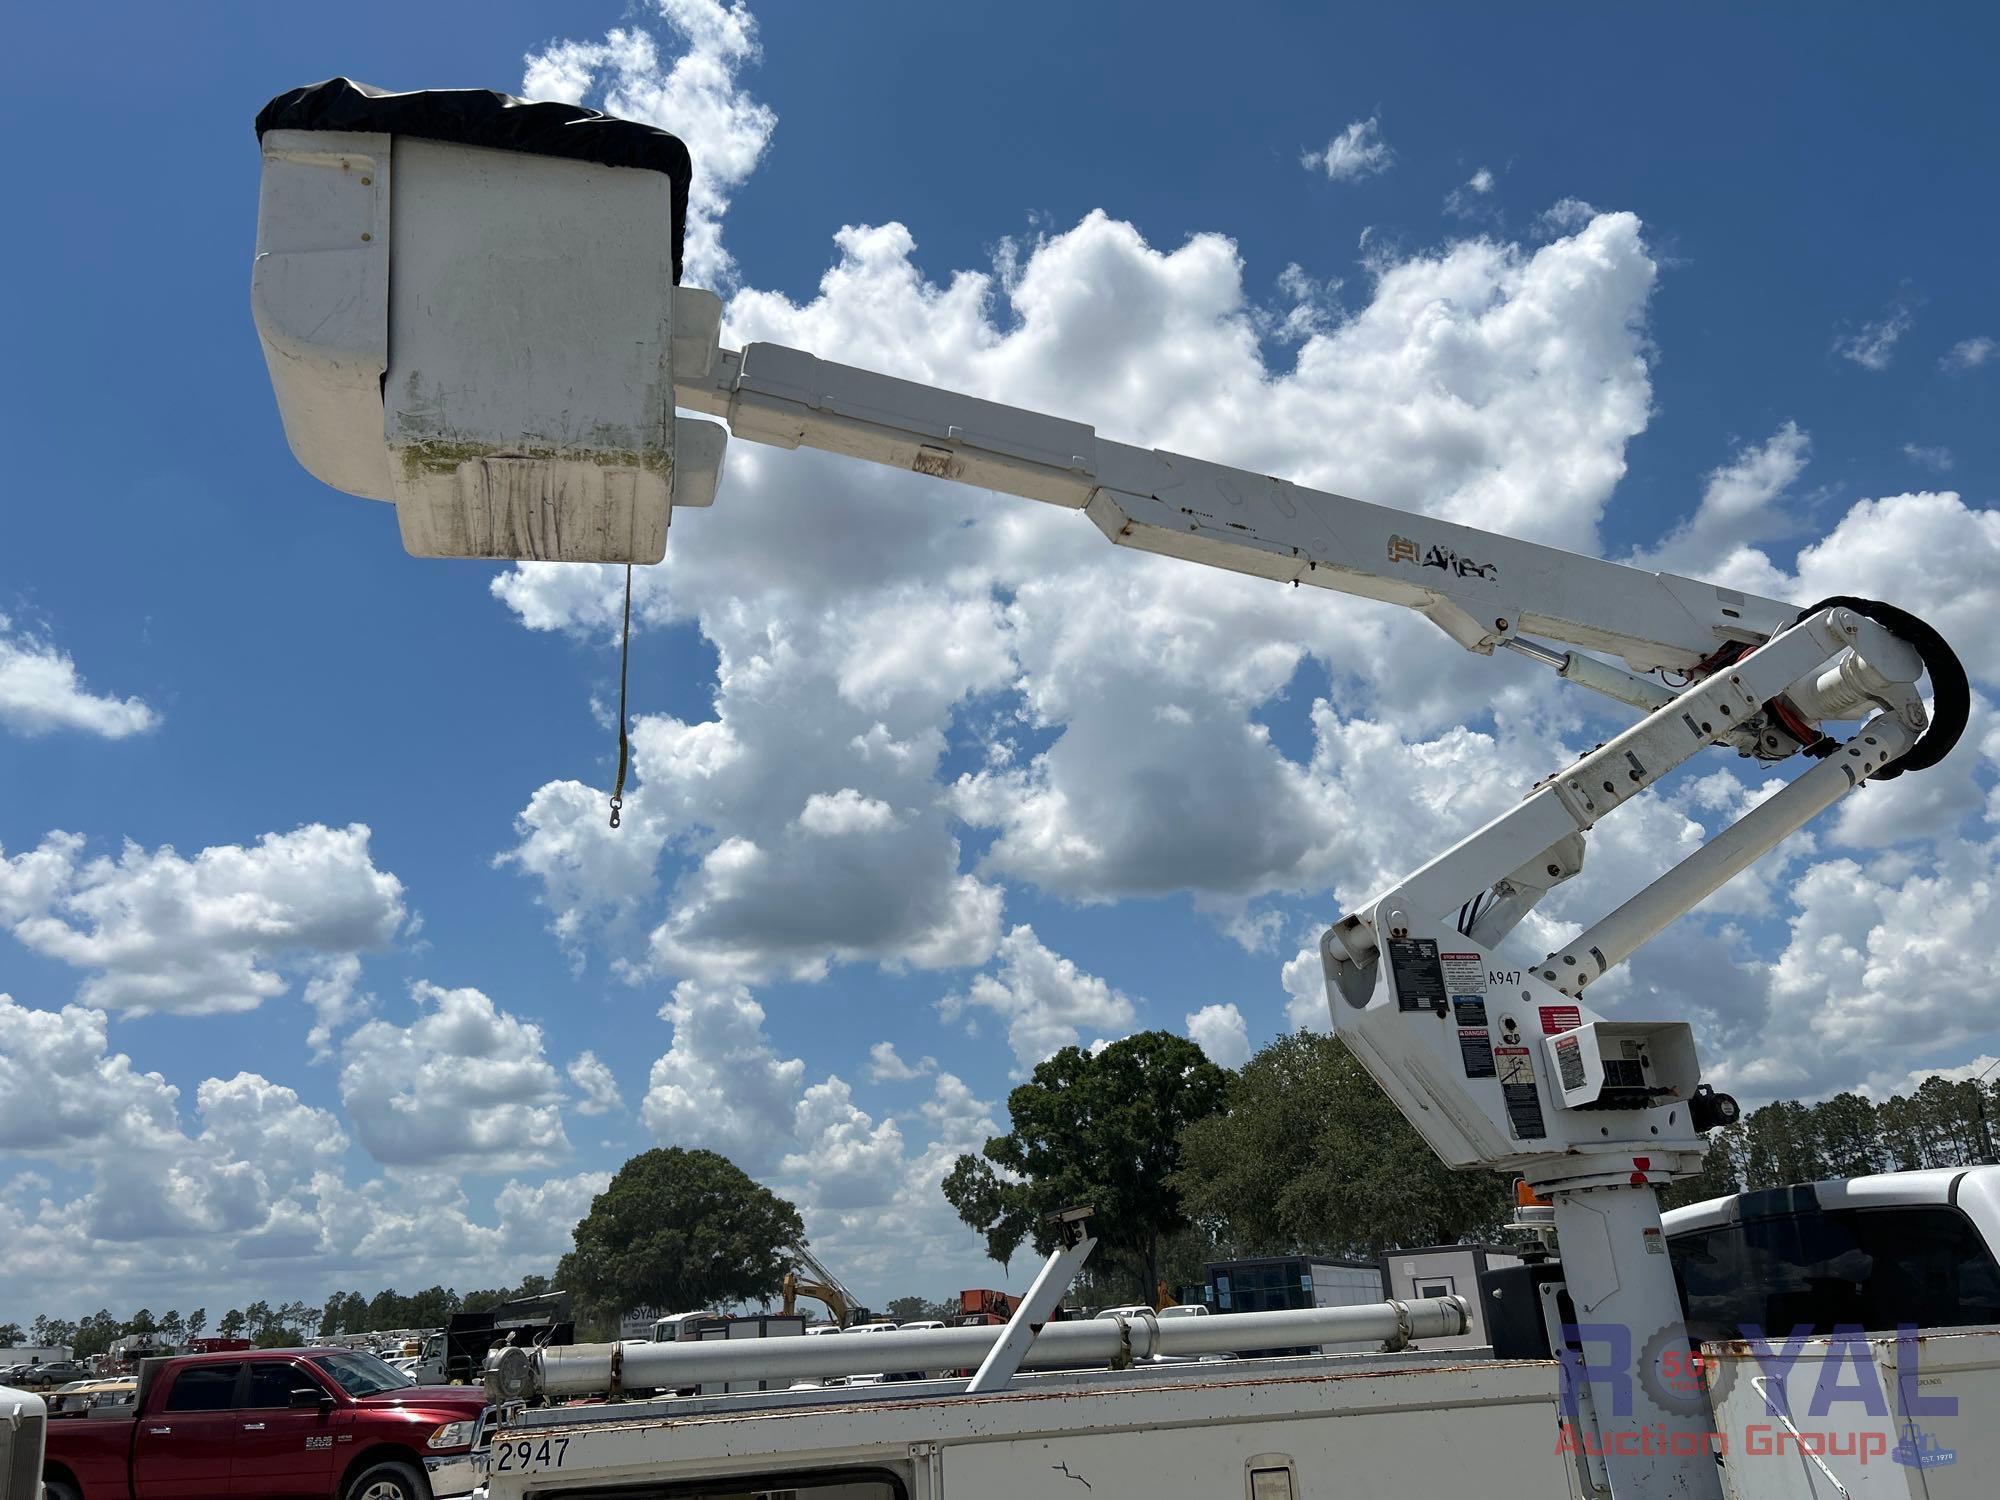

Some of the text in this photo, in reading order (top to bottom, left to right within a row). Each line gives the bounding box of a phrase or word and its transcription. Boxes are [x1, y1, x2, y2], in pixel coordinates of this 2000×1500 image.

[1489, 970, 1521, 986] A947
[962, 1316, 980, 1326] JLG
[497, 1437, 570, 1471] 2947
